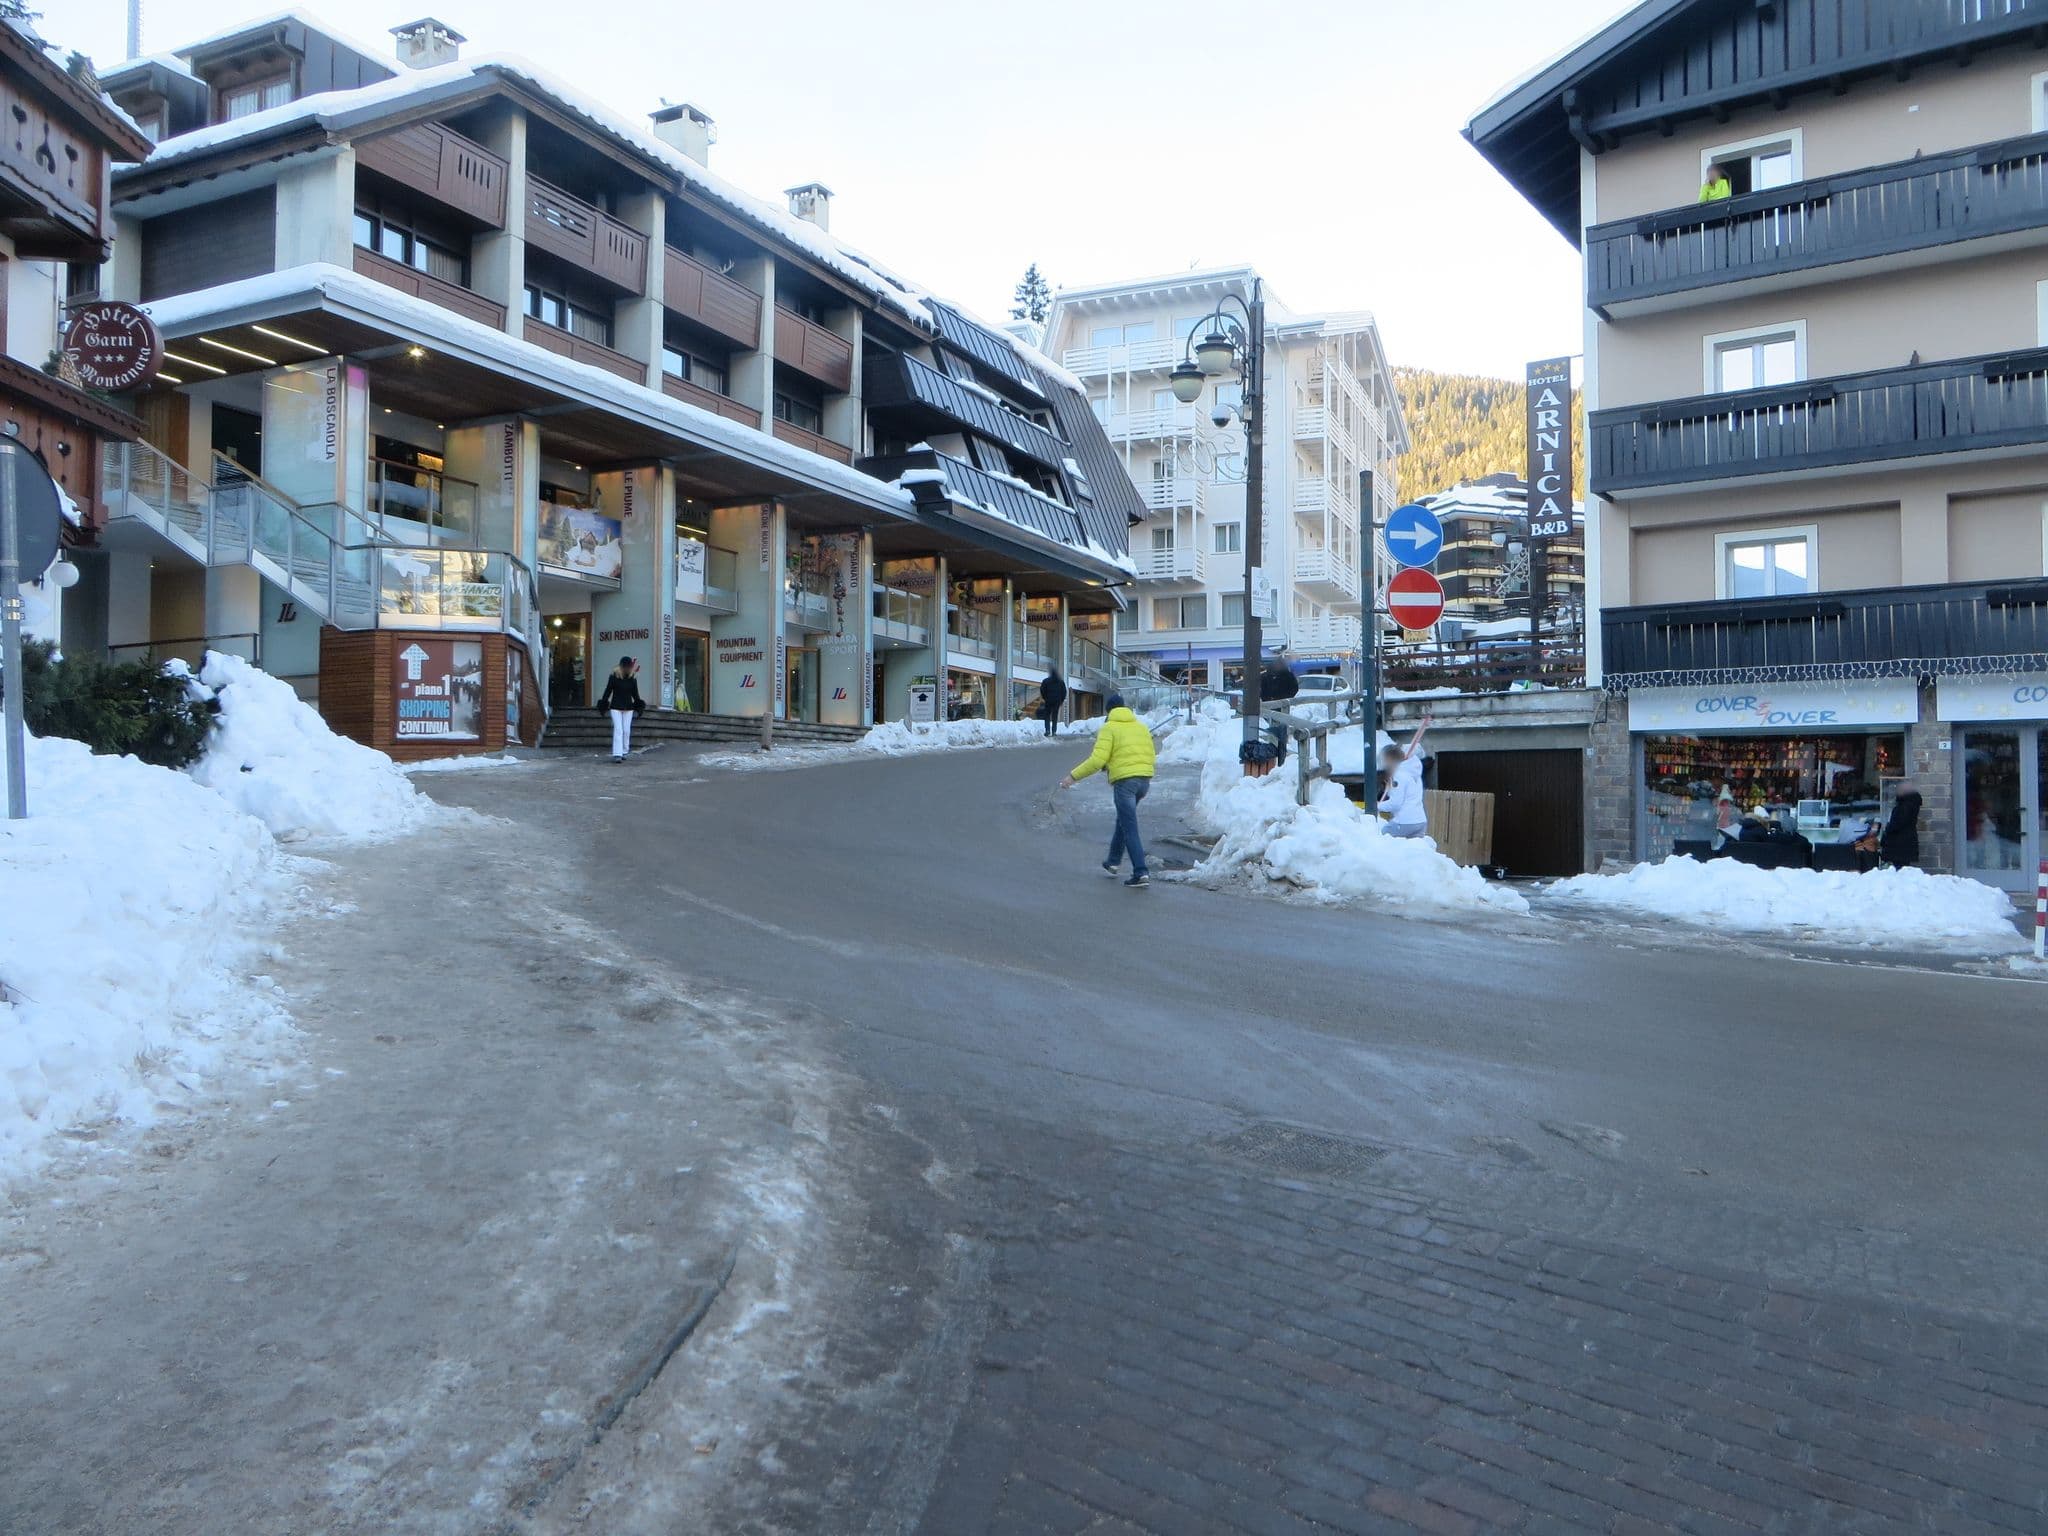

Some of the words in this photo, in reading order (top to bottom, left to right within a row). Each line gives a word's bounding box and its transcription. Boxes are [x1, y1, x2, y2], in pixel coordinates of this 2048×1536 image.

[83, 307, 141, 330] Hotel
[85, 332, 133, 347] Garni
[78, 347, 152, 387] Montanara
[326, 367, 336, 384] LA
[1527, 374, 1568, 387] HOTEL
[325, 387, 336, 460] BOSCAIOLA
[504, 423, 513, 481] ZAMBOTTI
[1534, 388, 1563, 517] ARNICA
[623, 471, 632, 483] LE
[623, 486, 632, 518] PIUME
[1531, 520, 1569, 537] B&B
[1027, 613, 1059, 622] ARMACIA
[599, 631, 612, 641] SKI
[614, 628, 649, 640] RENTING
[716, 637, 756, 648] MOUNTAIN
[720, 651, 763, 663] EQUIPMENT
[415, 682, 443, 697] piano
[441, 674, 451, 696] 1
[399, 699, 450, 719] SHOPPING
[1695, 696, 1758, 714] COVER
[1767, 710, 1838, 724] OVER
[399, 720, 450, 733] CONTINUA
